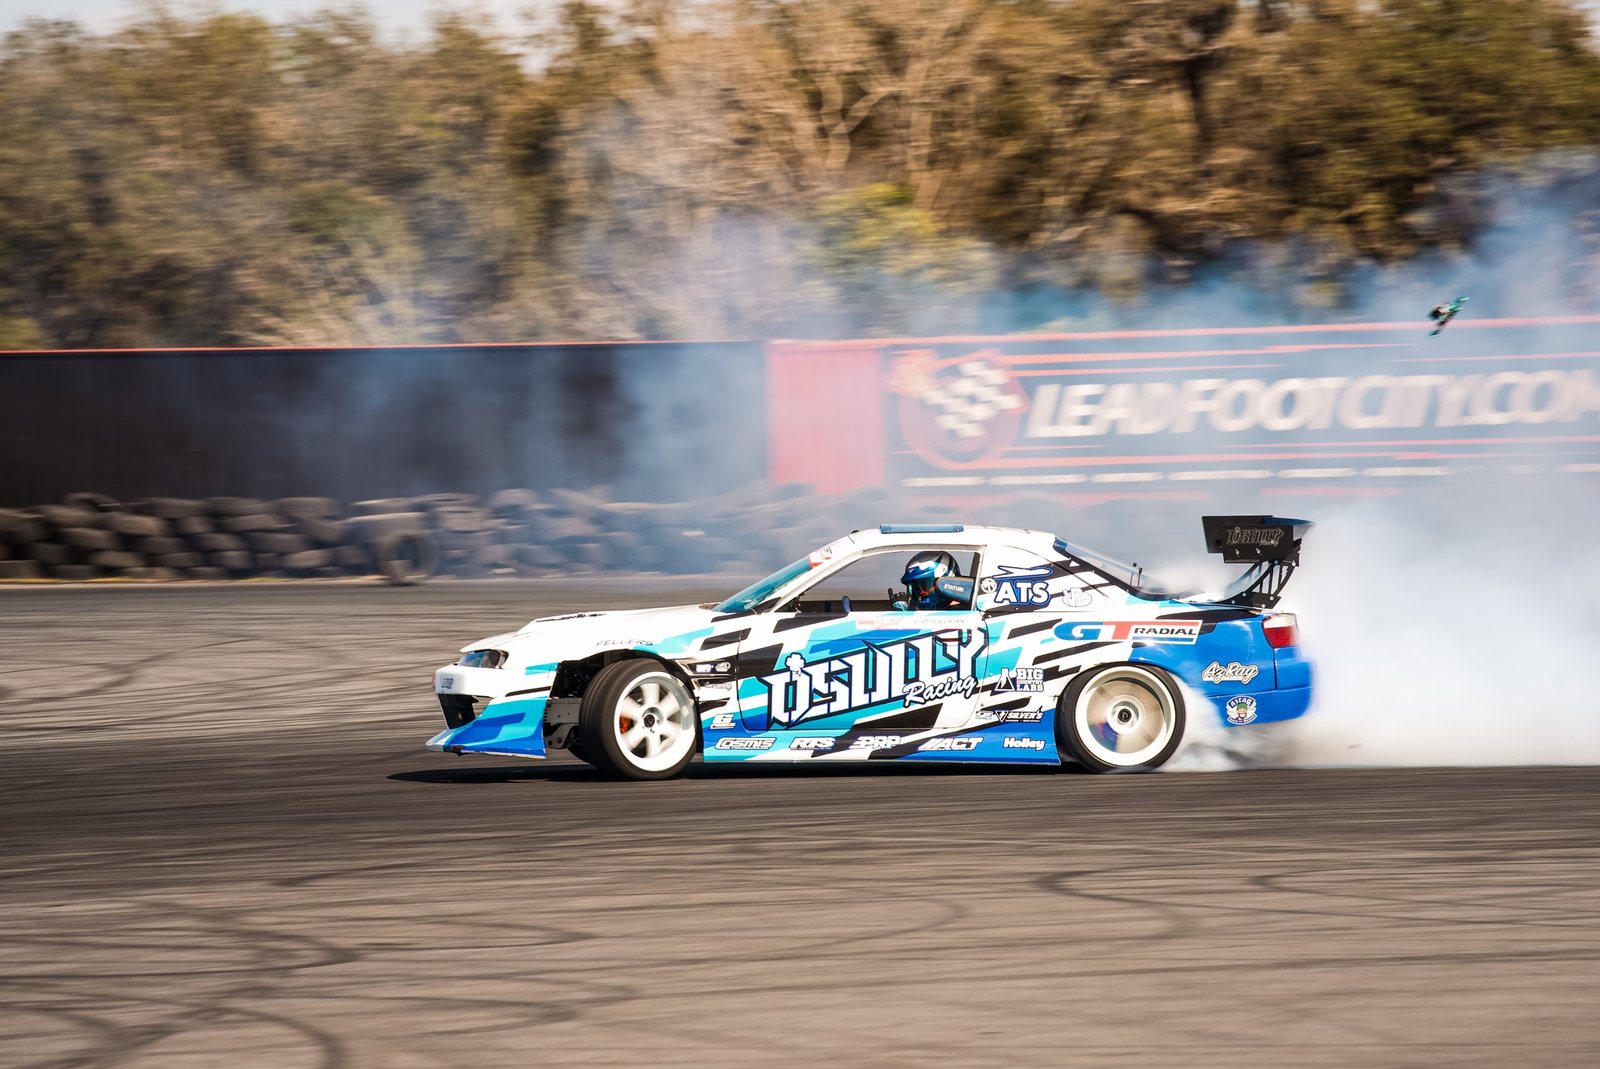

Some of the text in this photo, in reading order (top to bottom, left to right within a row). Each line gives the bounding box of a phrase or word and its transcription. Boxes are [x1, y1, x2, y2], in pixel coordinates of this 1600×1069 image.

[994, 581, 1050, 604] ATS
[1054, 621, 1197, 641] GT RADIAL
[1016, 668, 1044, 680] BIG
[903, 675, 978, 707] Racing
[1016, 684, 1044, 692] LABS
[1004, 737, 1046, 751] Holley
